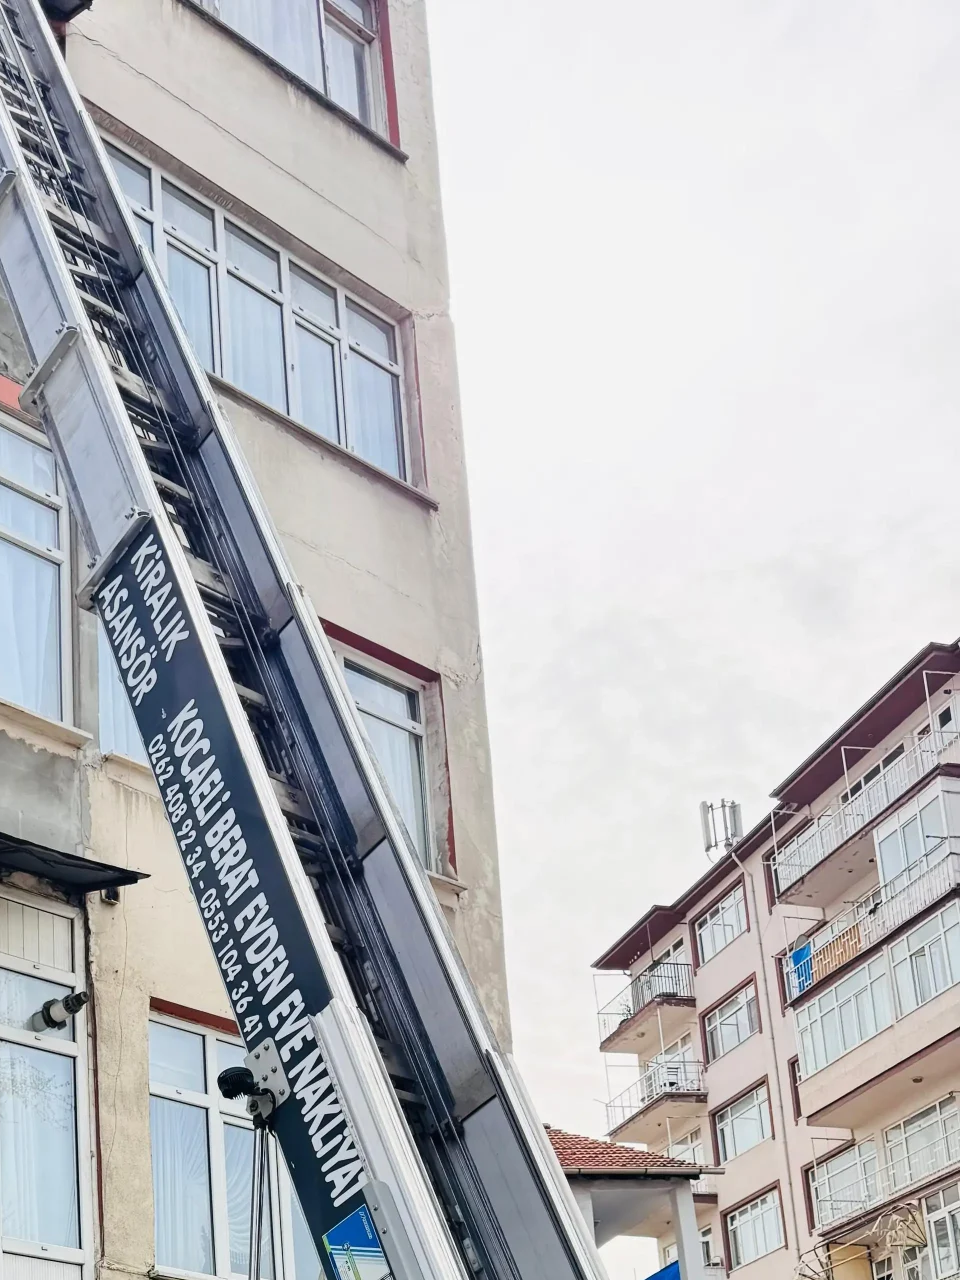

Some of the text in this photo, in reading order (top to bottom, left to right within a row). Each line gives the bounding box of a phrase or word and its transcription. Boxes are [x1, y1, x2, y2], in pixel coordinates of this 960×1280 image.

[98, 574, 158, 706] ASANSÖR
[148, 733, 174, 786] 0262
[165, 783, 188, 823] 408
[177, 818, 196, 851] 92
[186, 846, 206, 879] 34
[201, 888, 228, 943] 0553
[205, 807, 260, 906] BERAT
[234, 892, 294, 1005] EVDEN
[267, 988, 315, 1062] EVE
[218, 938, 242, 982] 104
[232, 980, 253, 1013] 36
[243, 1014, 263, 1041] 41
